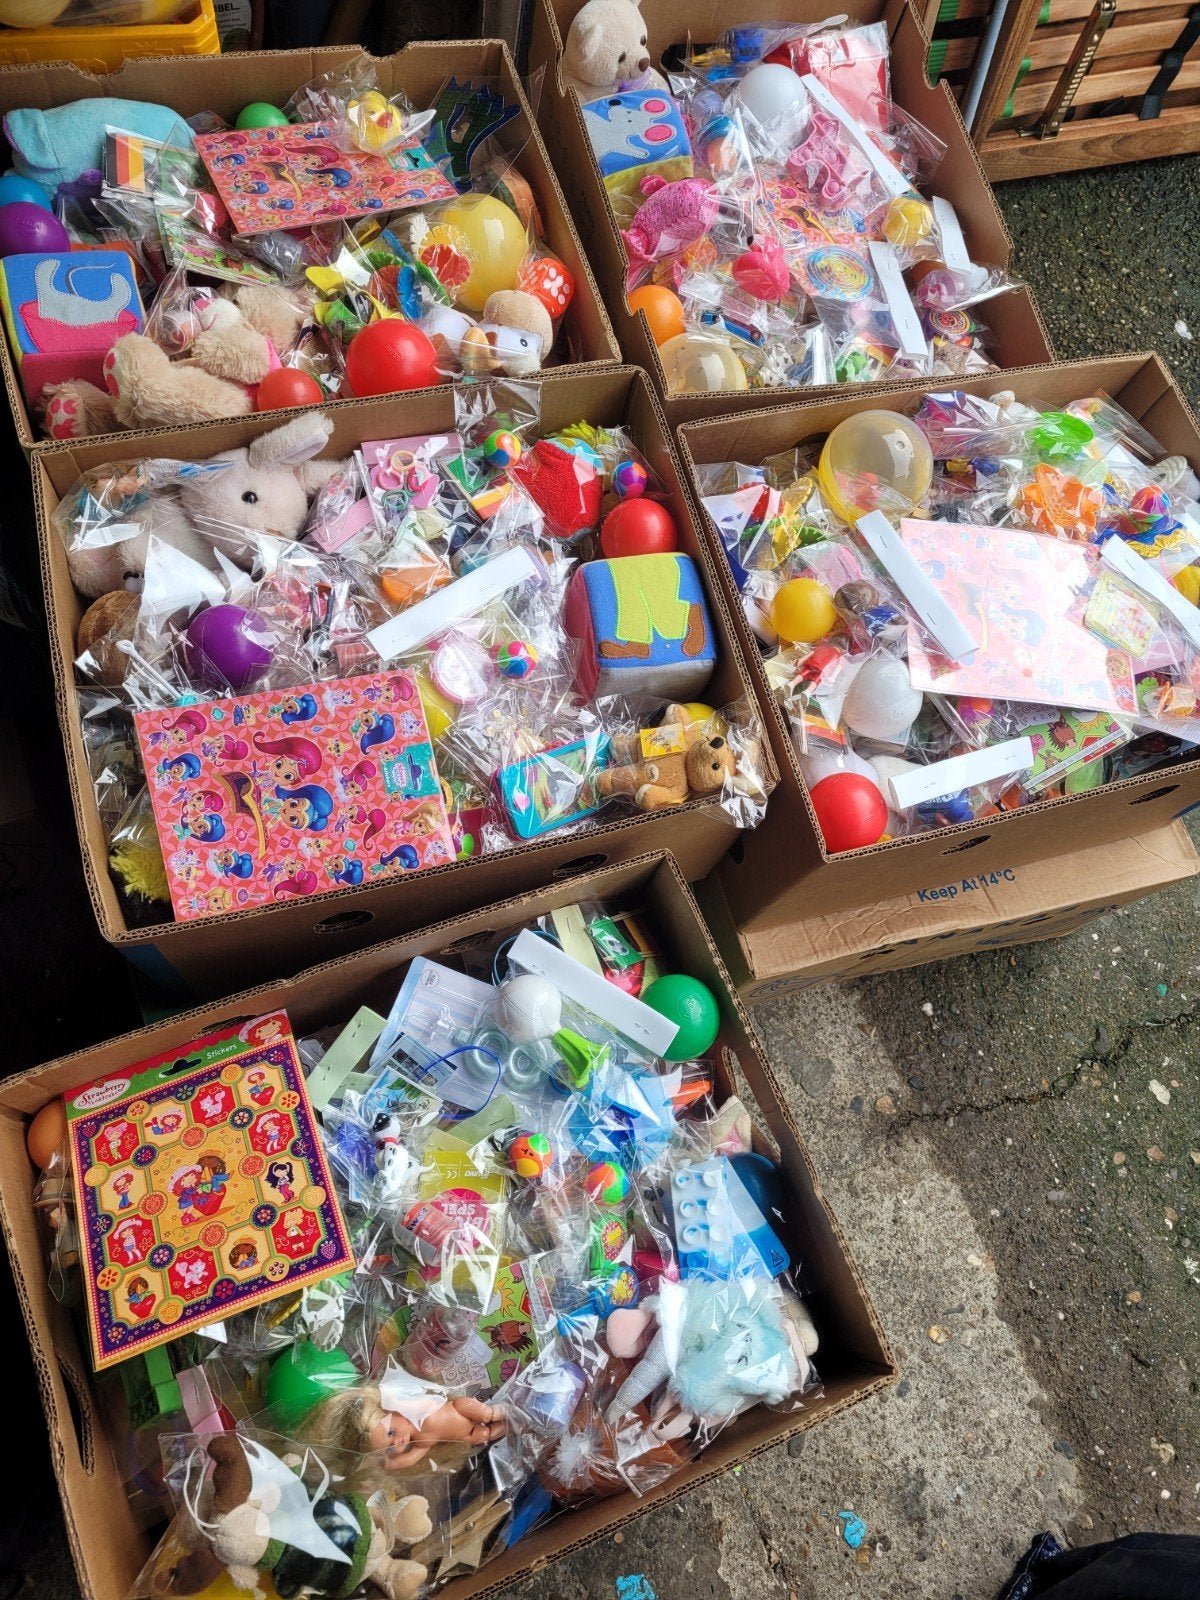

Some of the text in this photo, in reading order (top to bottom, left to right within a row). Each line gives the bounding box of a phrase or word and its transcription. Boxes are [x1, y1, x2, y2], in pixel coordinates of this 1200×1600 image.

[917, 868, 1016, 902] Keep At 14°C
[206, 1043, 238, 1060] Stickers
[77, 1081, 127, 1108] Strawberry
[440, 1202, 477, 1216] SPEL
